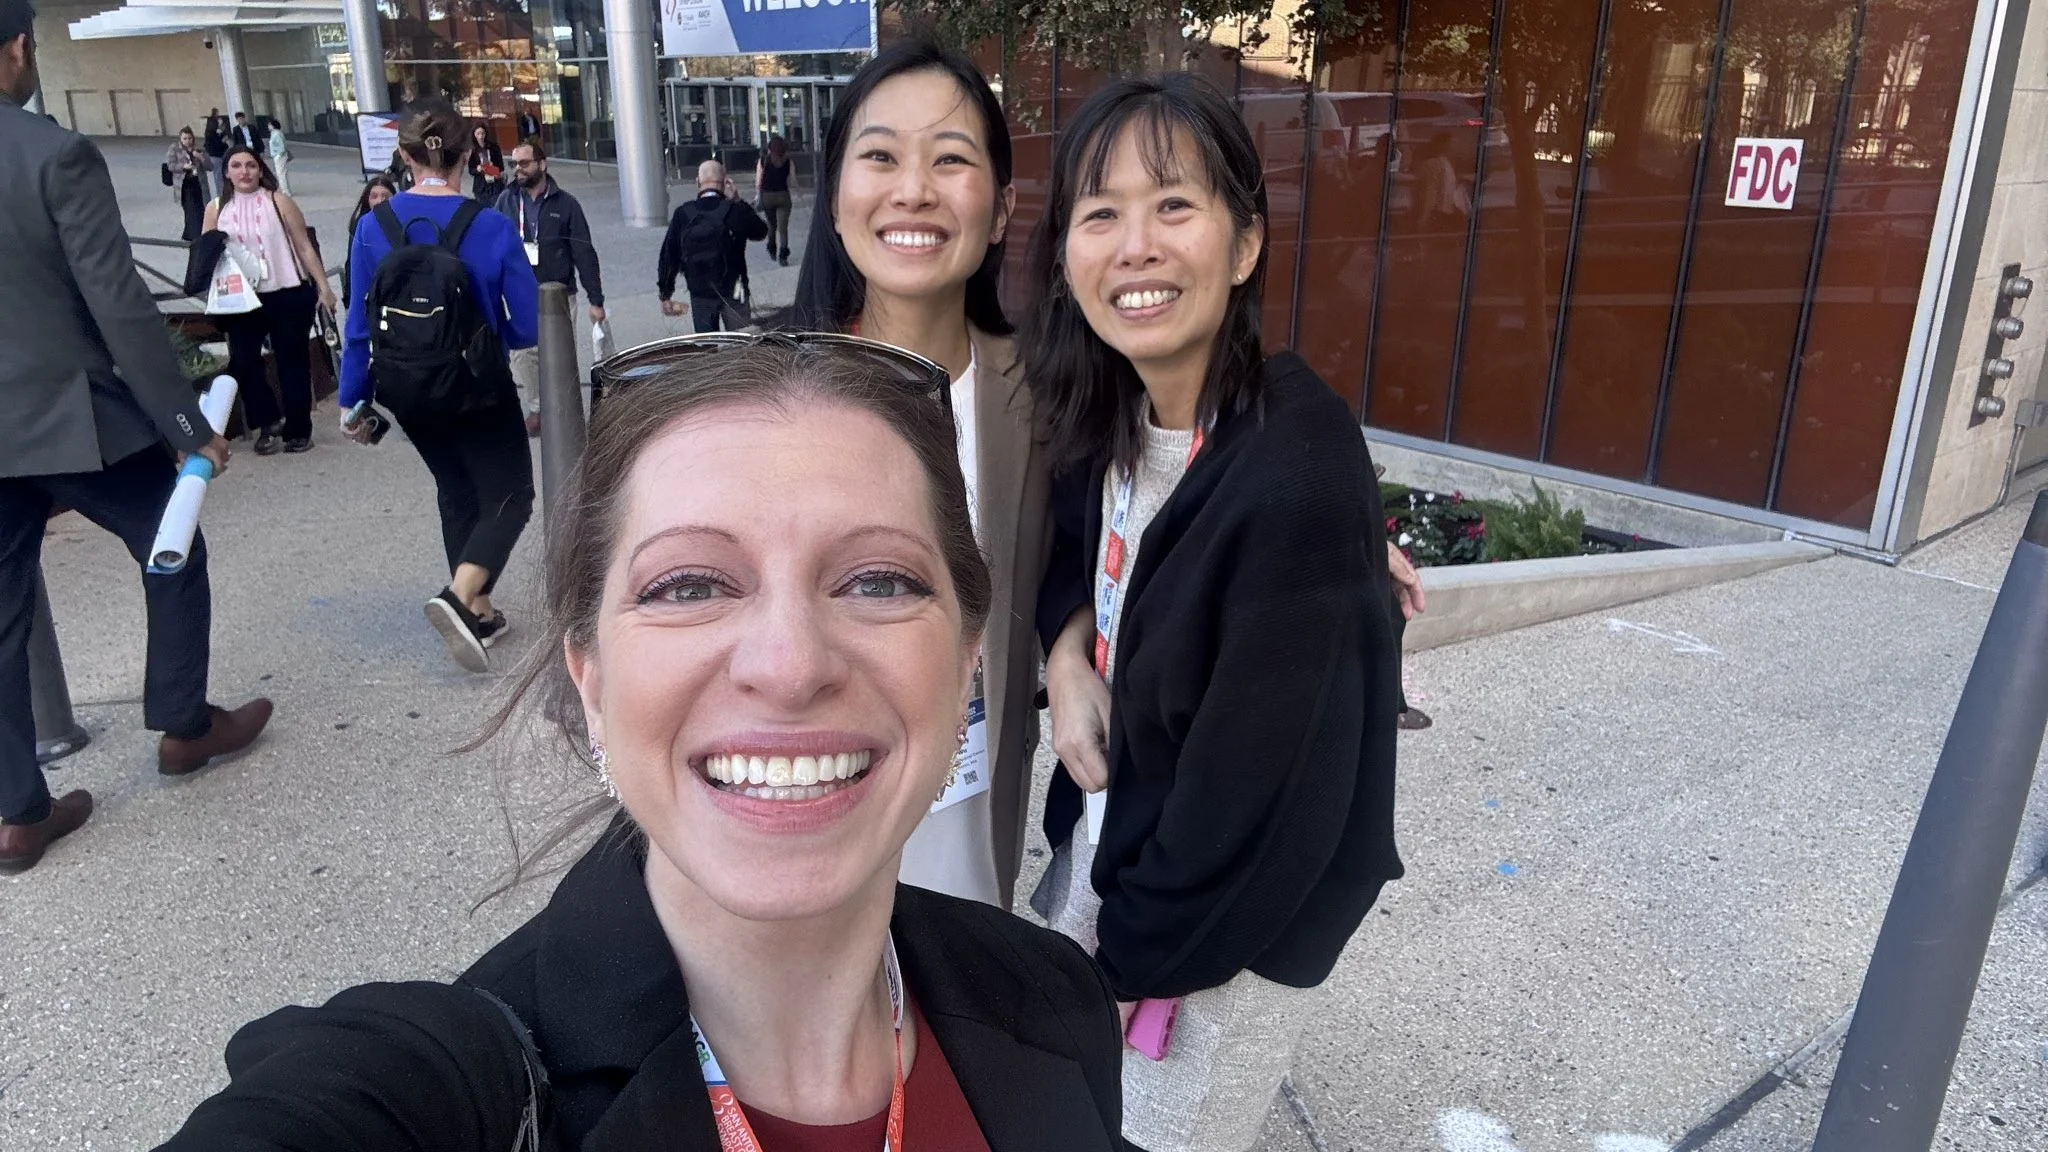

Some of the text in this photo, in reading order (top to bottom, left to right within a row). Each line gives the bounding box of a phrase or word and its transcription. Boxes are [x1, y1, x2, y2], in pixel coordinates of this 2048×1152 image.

[1728, 145, 1797, 204] FDC
[721, 1115, 743, 1148] BREAST
[727, 1107, 743, 1128] SAN
[737, 1127, 757, 1152] ANTO
